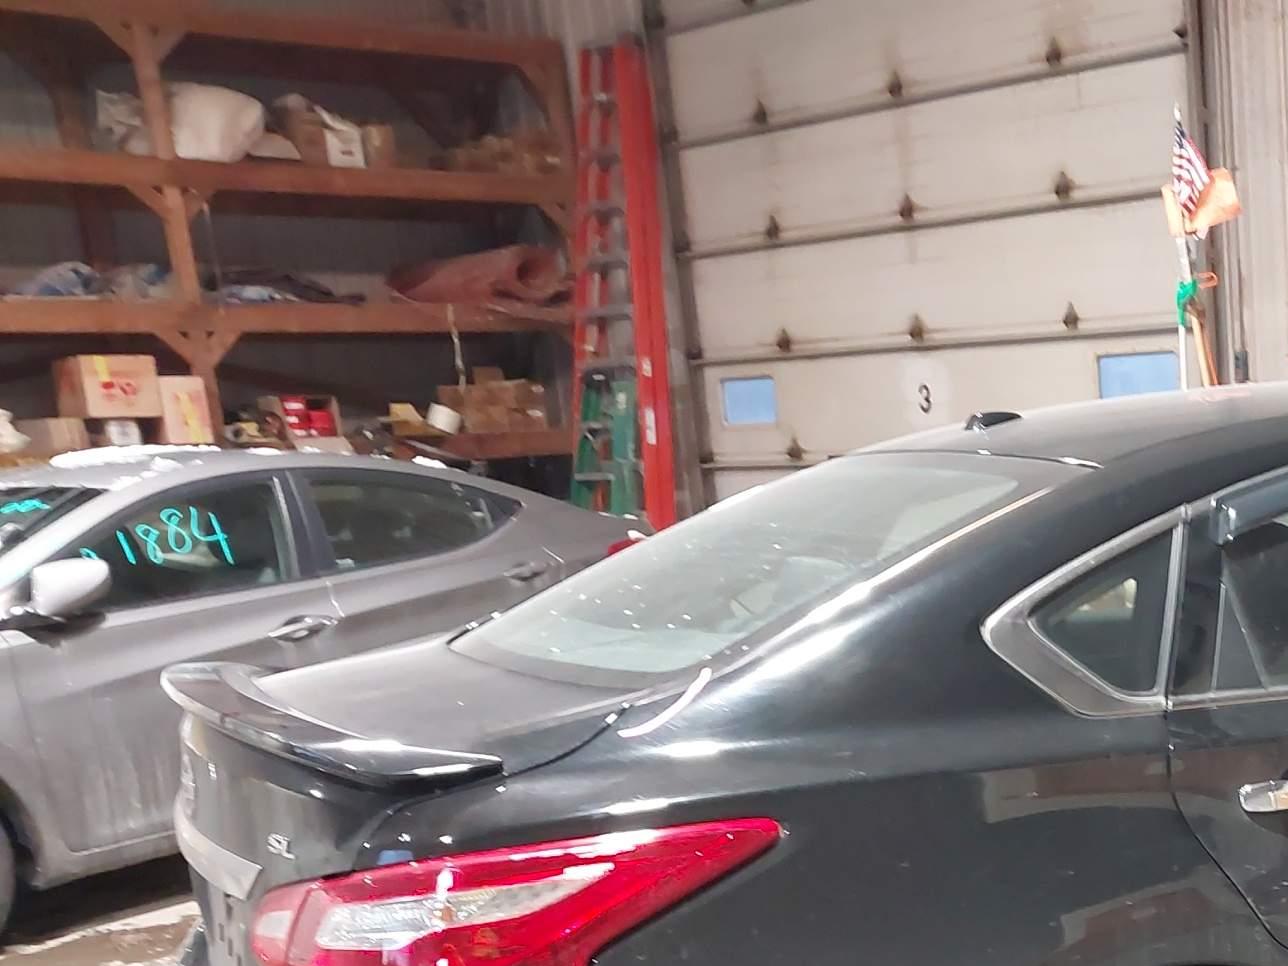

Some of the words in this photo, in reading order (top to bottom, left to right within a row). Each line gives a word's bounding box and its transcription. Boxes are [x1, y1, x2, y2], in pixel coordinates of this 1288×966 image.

[918, 384, 934, 414] 3
[116, 505, 236, 566] 1884
[267, 833, 296, 860] SL
